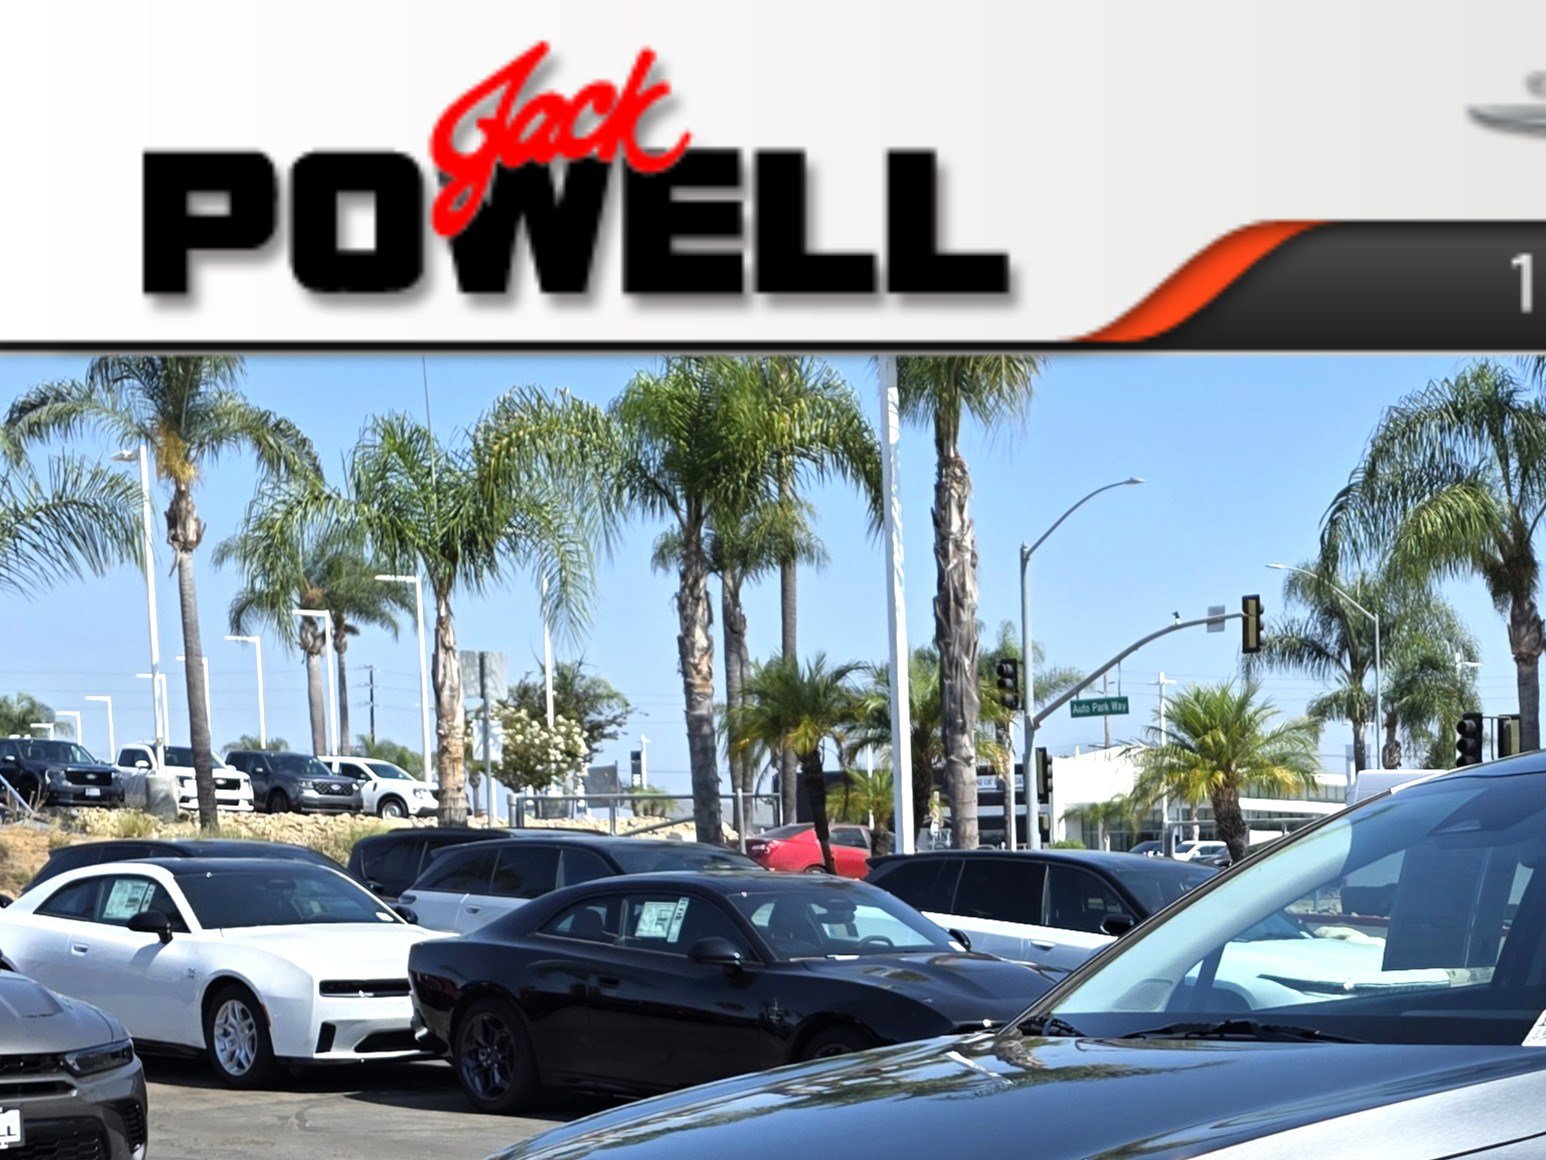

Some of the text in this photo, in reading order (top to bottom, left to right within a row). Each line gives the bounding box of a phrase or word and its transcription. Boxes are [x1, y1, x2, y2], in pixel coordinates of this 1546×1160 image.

[1073, 701, 1127, 714] Auto Park Way
